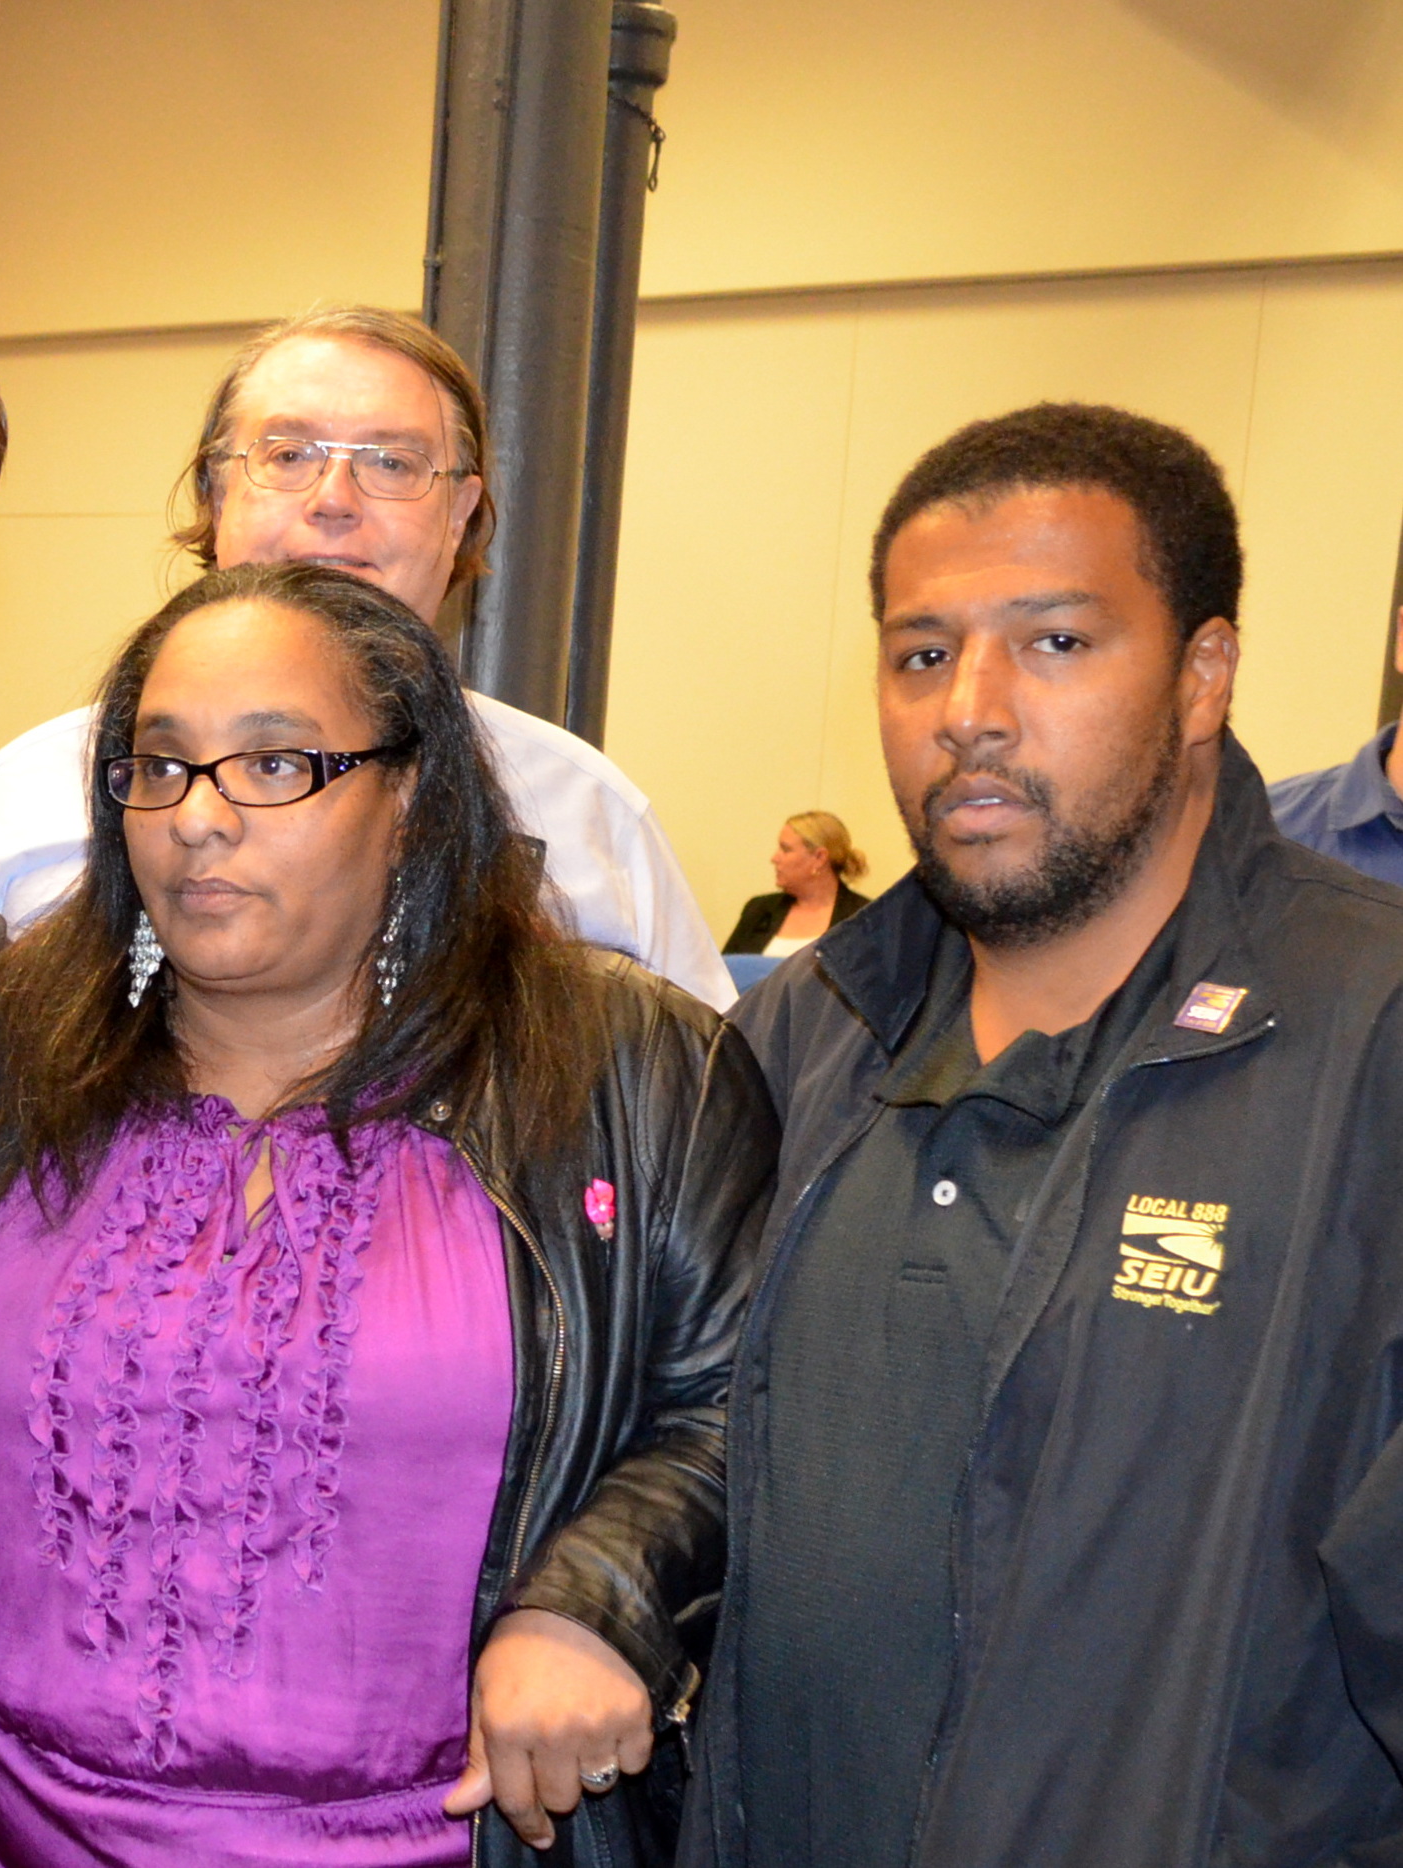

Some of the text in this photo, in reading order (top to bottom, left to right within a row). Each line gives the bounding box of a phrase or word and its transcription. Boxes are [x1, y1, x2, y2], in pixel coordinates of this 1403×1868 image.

[1126, 1194, 1229, 1223] LOCAL 888
[1114, 1259, 1217, 1297] SEIU
